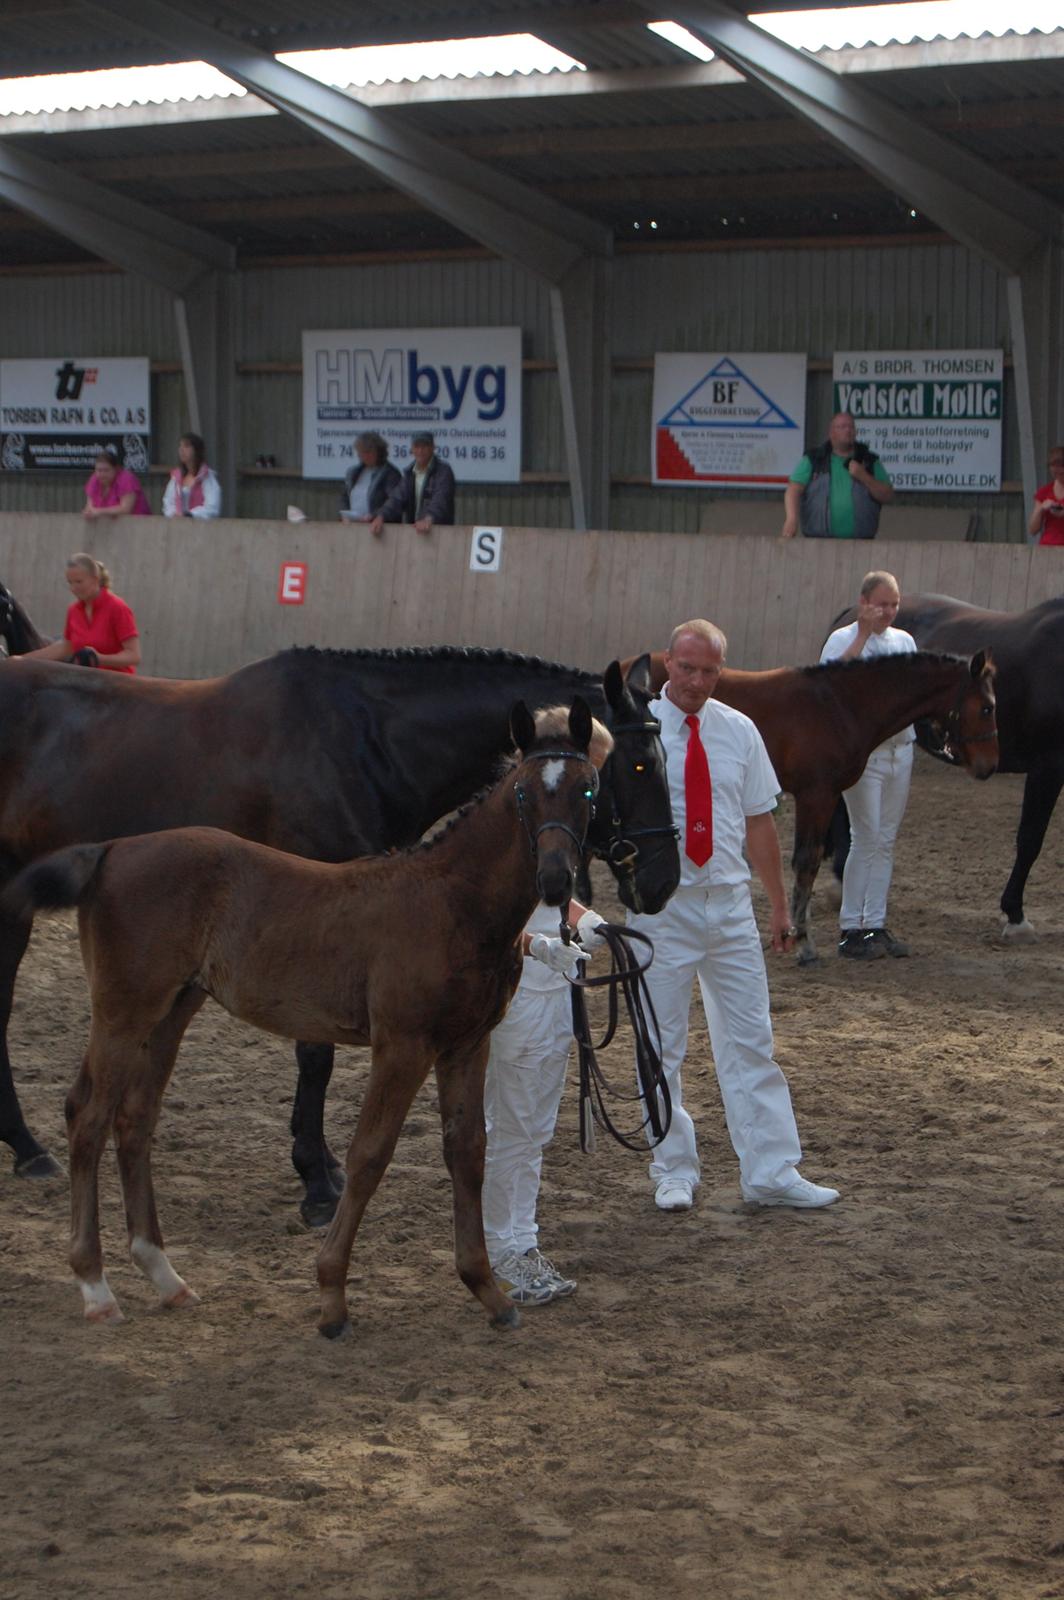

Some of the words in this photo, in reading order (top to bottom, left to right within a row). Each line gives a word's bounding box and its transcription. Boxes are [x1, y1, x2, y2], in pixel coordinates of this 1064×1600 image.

[842, 360, 868, 374] A/S
[875, 360, 916, 374] BRDR.
[923, 360, 994, 373] THOMSEN
[315, 348, 506, 421] HMbyg
[713, 381, 739, 404] BF
[838, 382, 924, 417] Vedsted
[933, 382, 998, 417] Mølle
[3, 407, 46, 424] TORBEN
[51, 407, 83, 424] RAFN
[88, 407, 95, 424] &
[101, 407, 120, 424] CO.
[875, 428, 888, 437] og
[892, 426, 990, 438] foderstofforretning
[317, 445, 335, 459] Tlf.
[393, 446, 407, 458] 36
[454, 447, 467, 459] 14
[472, 447, 486, 459] 86
[491, 447, 505, 460] 36
[882, 440, 908, 450] foder
[913, 440, 922, 450] til
[926, 440, 974, 451] hobbydyr
[903, 454, 955, 465] rideudstyr
[476, 533, 496, 565] S
[283, 567, 303, 599] E
